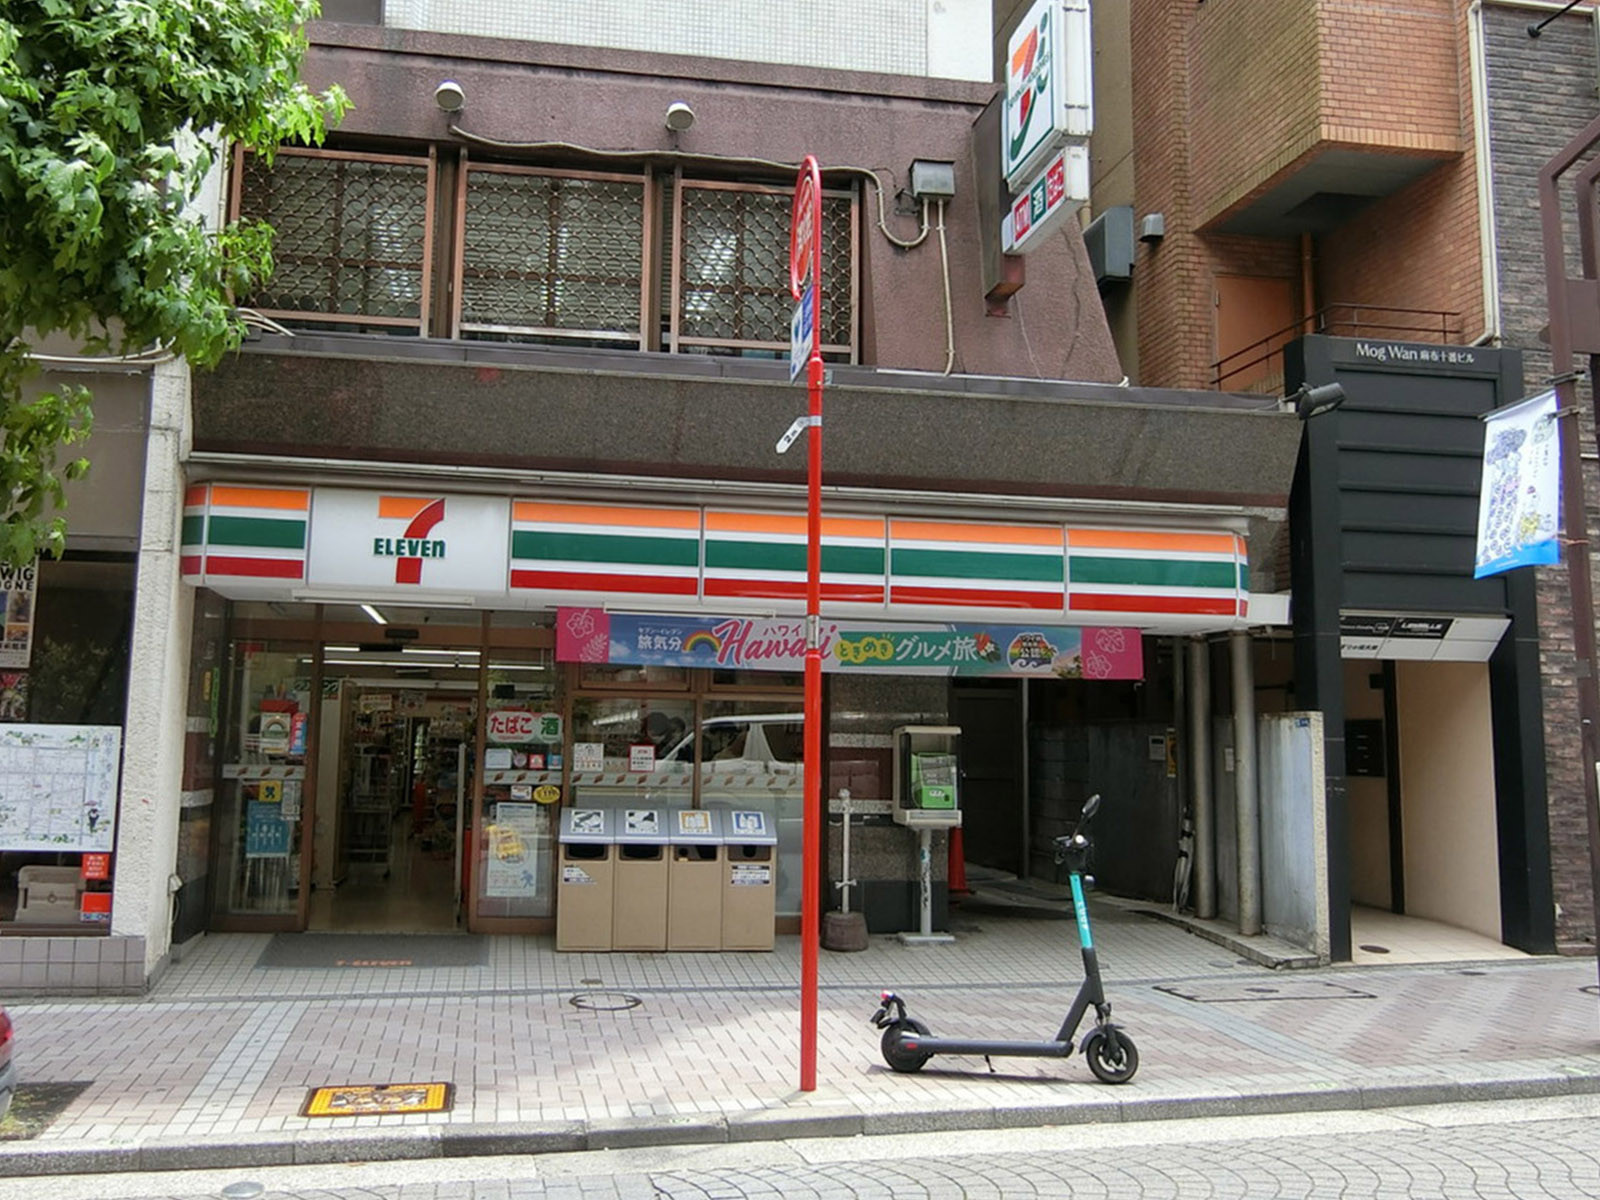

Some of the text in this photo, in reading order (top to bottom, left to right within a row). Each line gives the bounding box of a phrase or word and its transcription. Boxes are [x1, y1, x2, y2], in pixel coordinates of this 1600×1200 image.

[1356, 343, 1386, 361] Mog
[1388, 345, 1418, 360] Wan
[378, 495, 446, 584] 7
[0, 580, 35, 591] GNE
[712, 619, 837, 665] Hawai
[895, 634, 979, 661] グルメ旅
[490, 715, 560, 735] たばこ 酒
